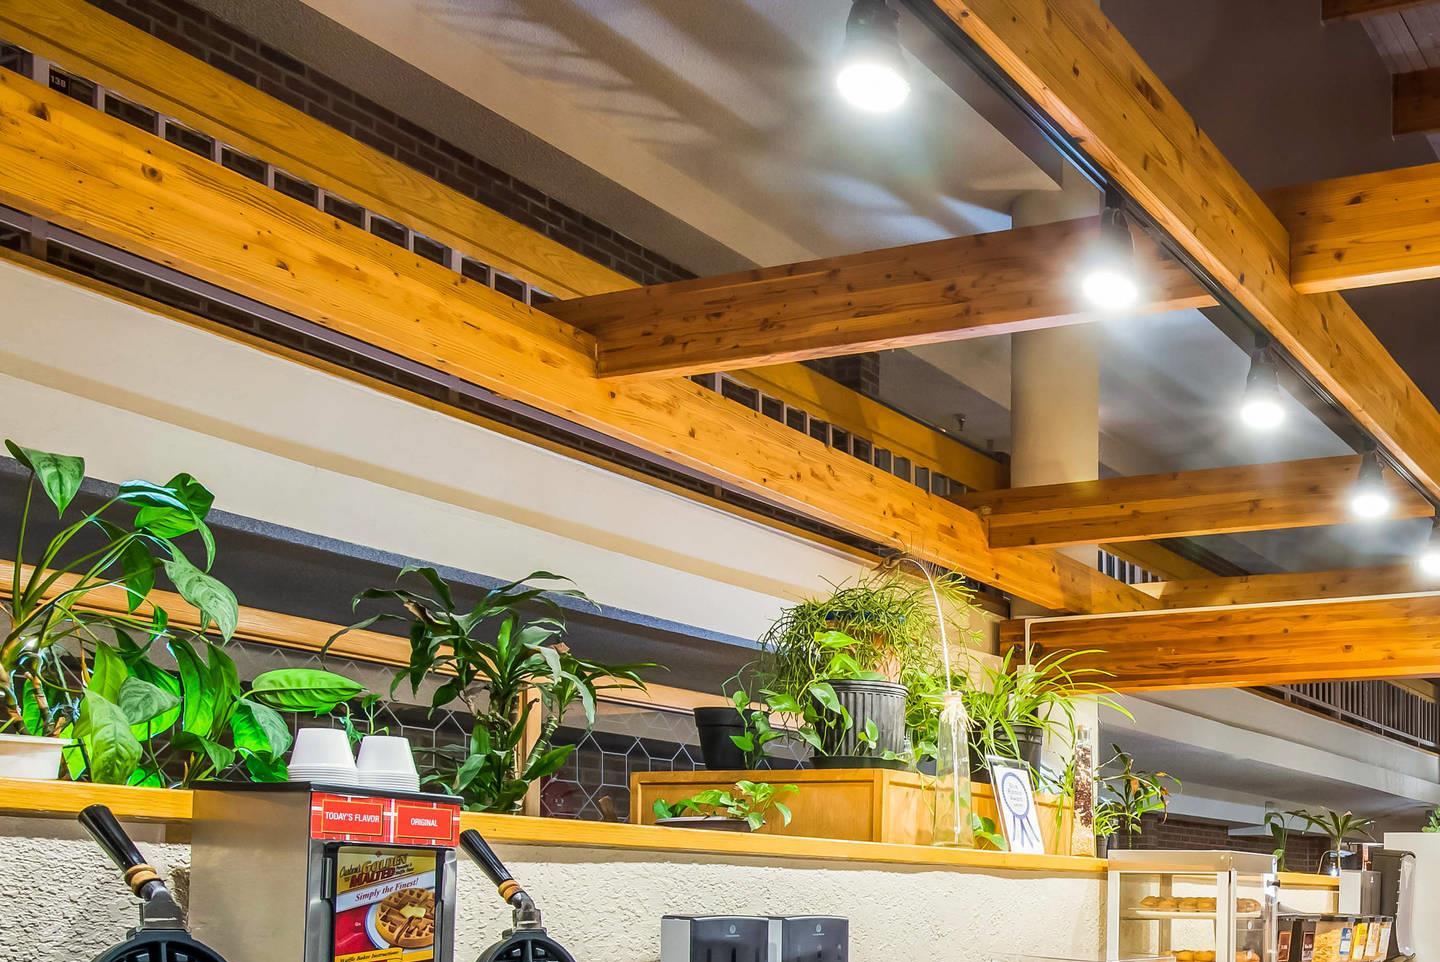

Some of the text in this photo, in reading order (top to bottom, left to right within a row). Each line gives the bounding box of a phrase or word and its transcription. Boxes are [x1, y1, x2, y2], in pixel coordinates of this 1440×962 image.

[325, 811, 380, 823] TODAY'S FLAVOR
[410, 817, 438, 827] ORIGINAL
[362, 854, 408, 873] GOLDEN
[349, 867, 396, 888] MALTED
[355, 878, 419, 902] Simply the Finest!
